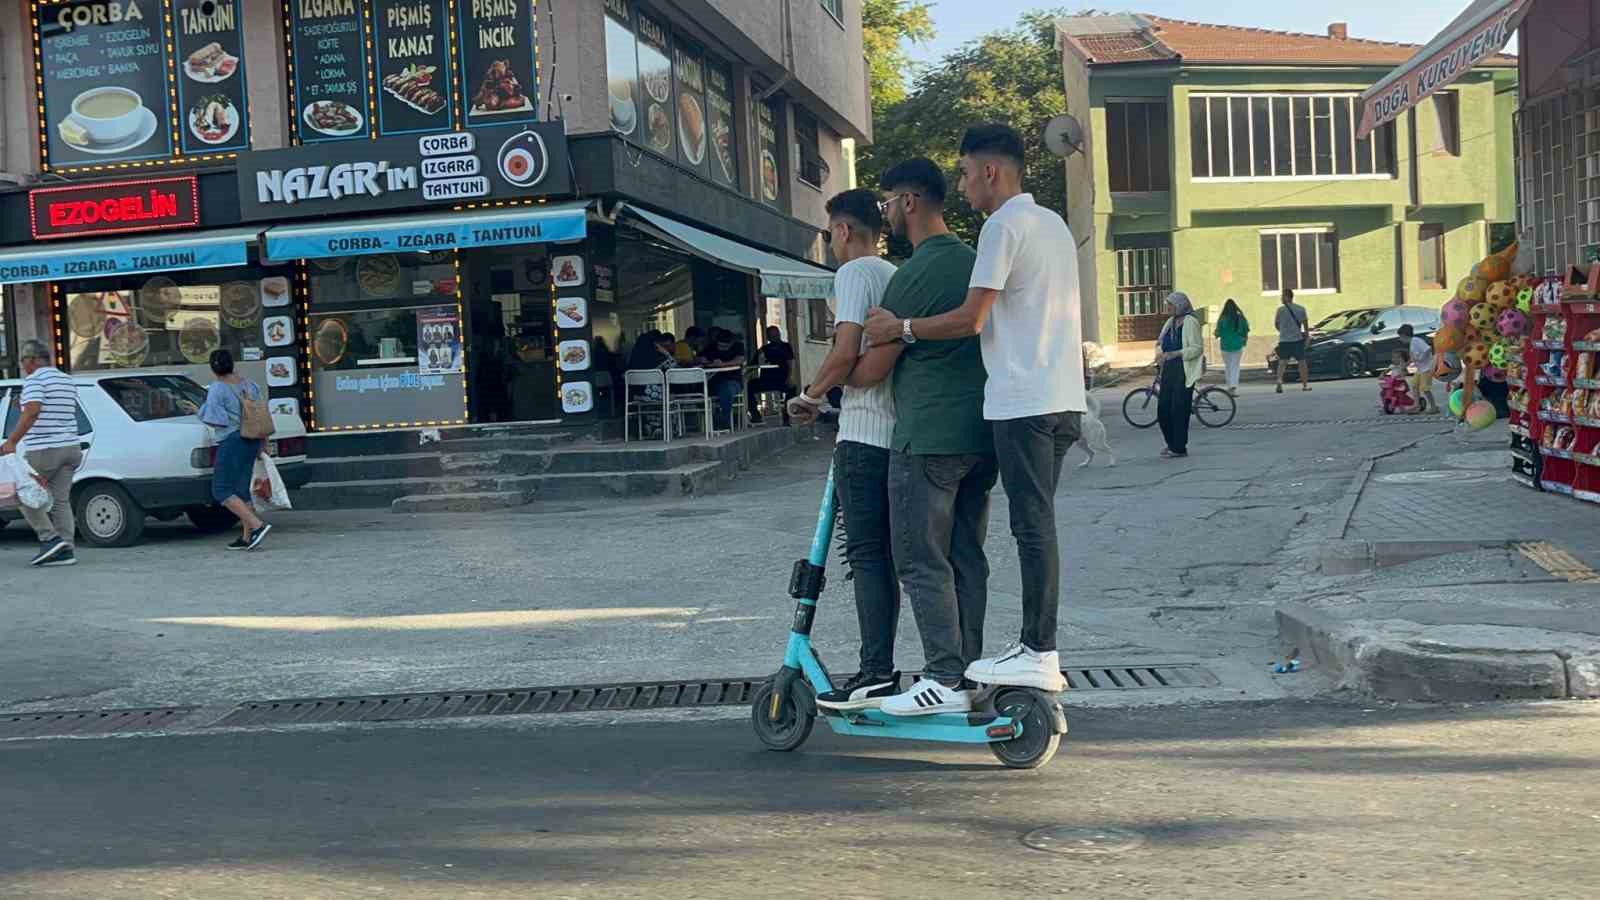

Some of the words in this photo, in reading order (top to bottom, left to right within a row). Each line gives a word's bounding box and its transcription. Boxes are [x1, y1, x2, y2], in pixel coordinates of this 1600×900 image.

[58, 2, 143, 33] ÇORBA
[387, 2, 432, 31] PİŞMİŞ
[388, 34, 434, 58] KANAT
[479, 22, 515, 49] İNCİK
[1374, 80, 1409, 122] DOĞA
[423, 136, 468, 154] ÇORBA
[424, 159, 475, 174] IZGARA
[425, 179, 484, 196] TANTUNİ
[50, 190, 177, 227] EZOGELİN
[398, 231, 456, 248] IZGARA
[472, 222, 542, 242] TANTUNİ
[0, 264, 49, 279] ÇORBA
[64, 259, 117, 273] IZGARA
[132, 250, 196, 268] TANTUNİ
